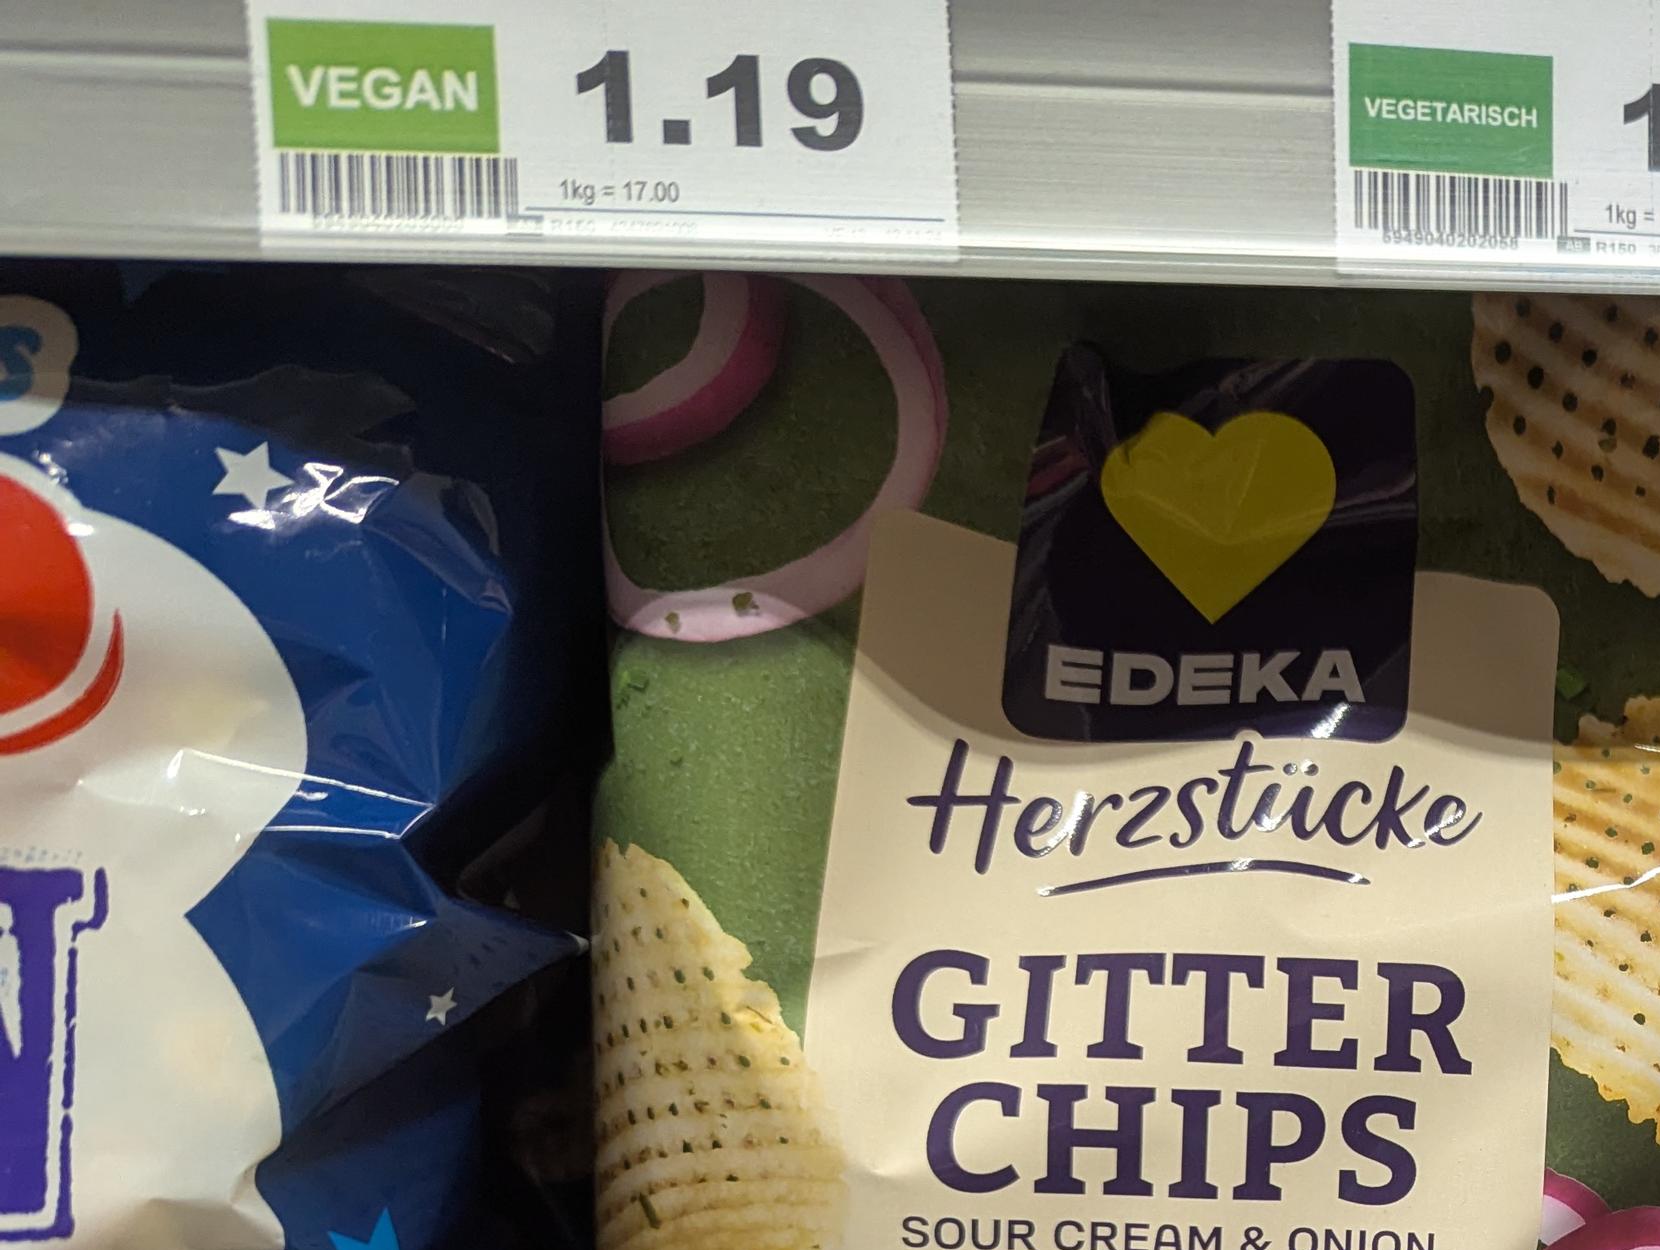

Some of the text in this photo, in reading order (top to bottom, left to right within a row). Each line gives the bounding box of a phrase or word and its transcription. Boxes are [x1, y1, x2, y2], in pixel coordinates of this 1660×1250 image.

[286, 64, 478, 113] VEGAN
[575, 49, 865, 152] 1.19
[1364, 96, 1539, 130] VEGETARISCH
[558, 179, 596, 207] 1kg
[623, 181, 681, 204] 17.00
[1605, 204, 1637, 229] 1kg
[1043, 643, 1366, 706] EDEKA
[907, 738, 1483, 876] Herzstücke
[891, 948, 1473, 1076] GITTER
[926, 1081, 1418, 1206] CHIPS
